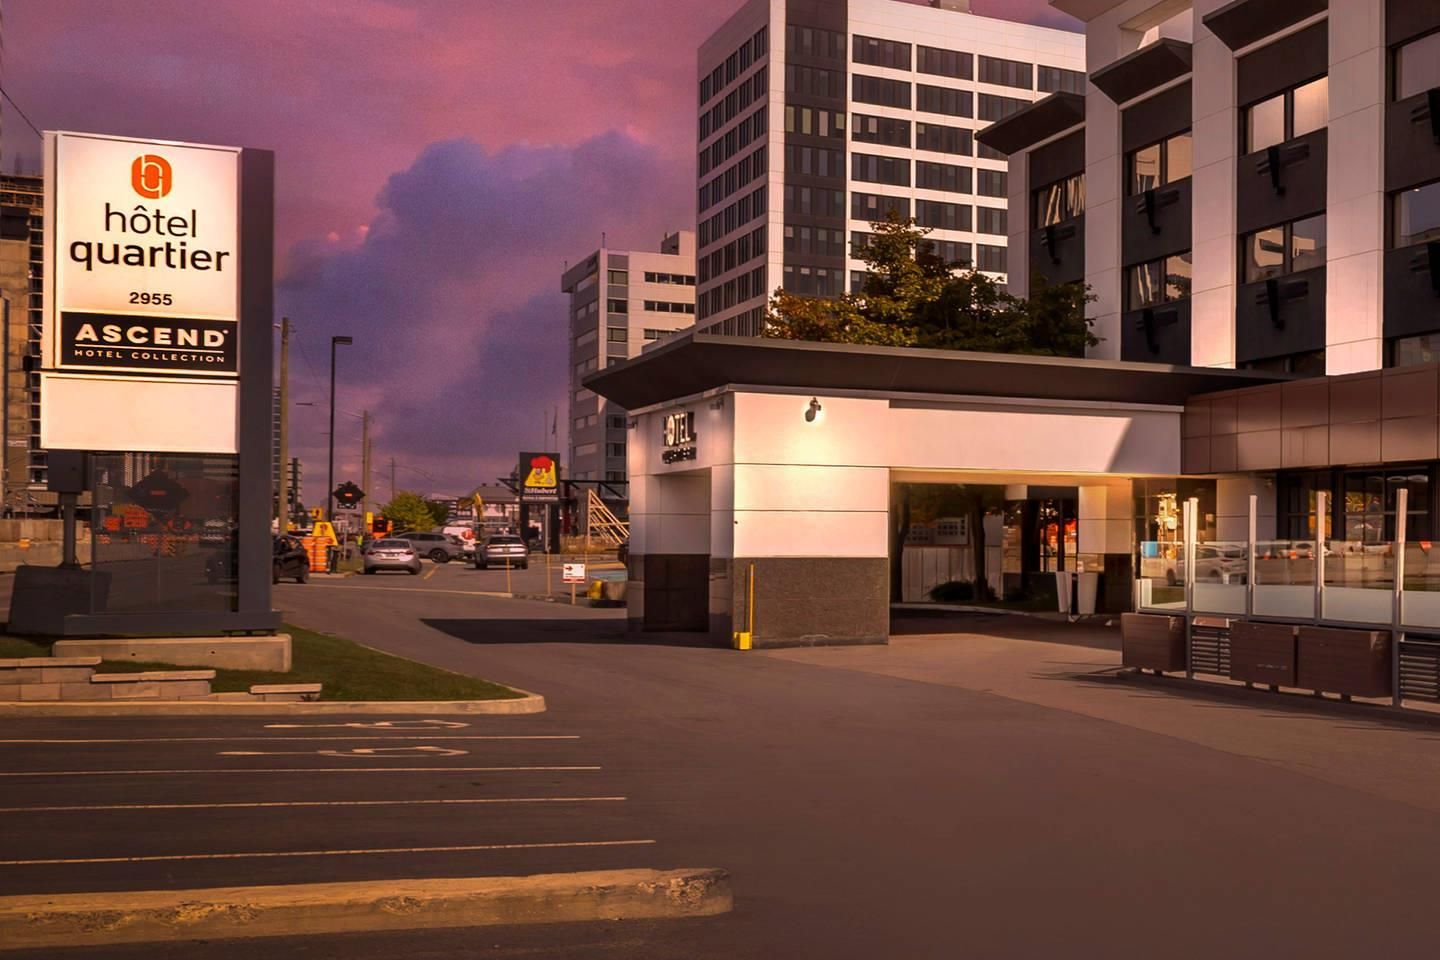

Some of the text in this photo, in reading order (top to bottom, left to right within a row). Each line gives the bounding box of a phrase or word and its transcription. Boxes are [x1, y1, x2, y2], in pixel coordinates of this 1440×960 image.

[105, 202, 197, 238] hôtel
[69, 240, 230, 272] quartier
[129, 291, 173, 306] 2955
[74, 323, 226, 348] ASCEND
[74, 349, 225, 363] HOTEL COLLECTION
